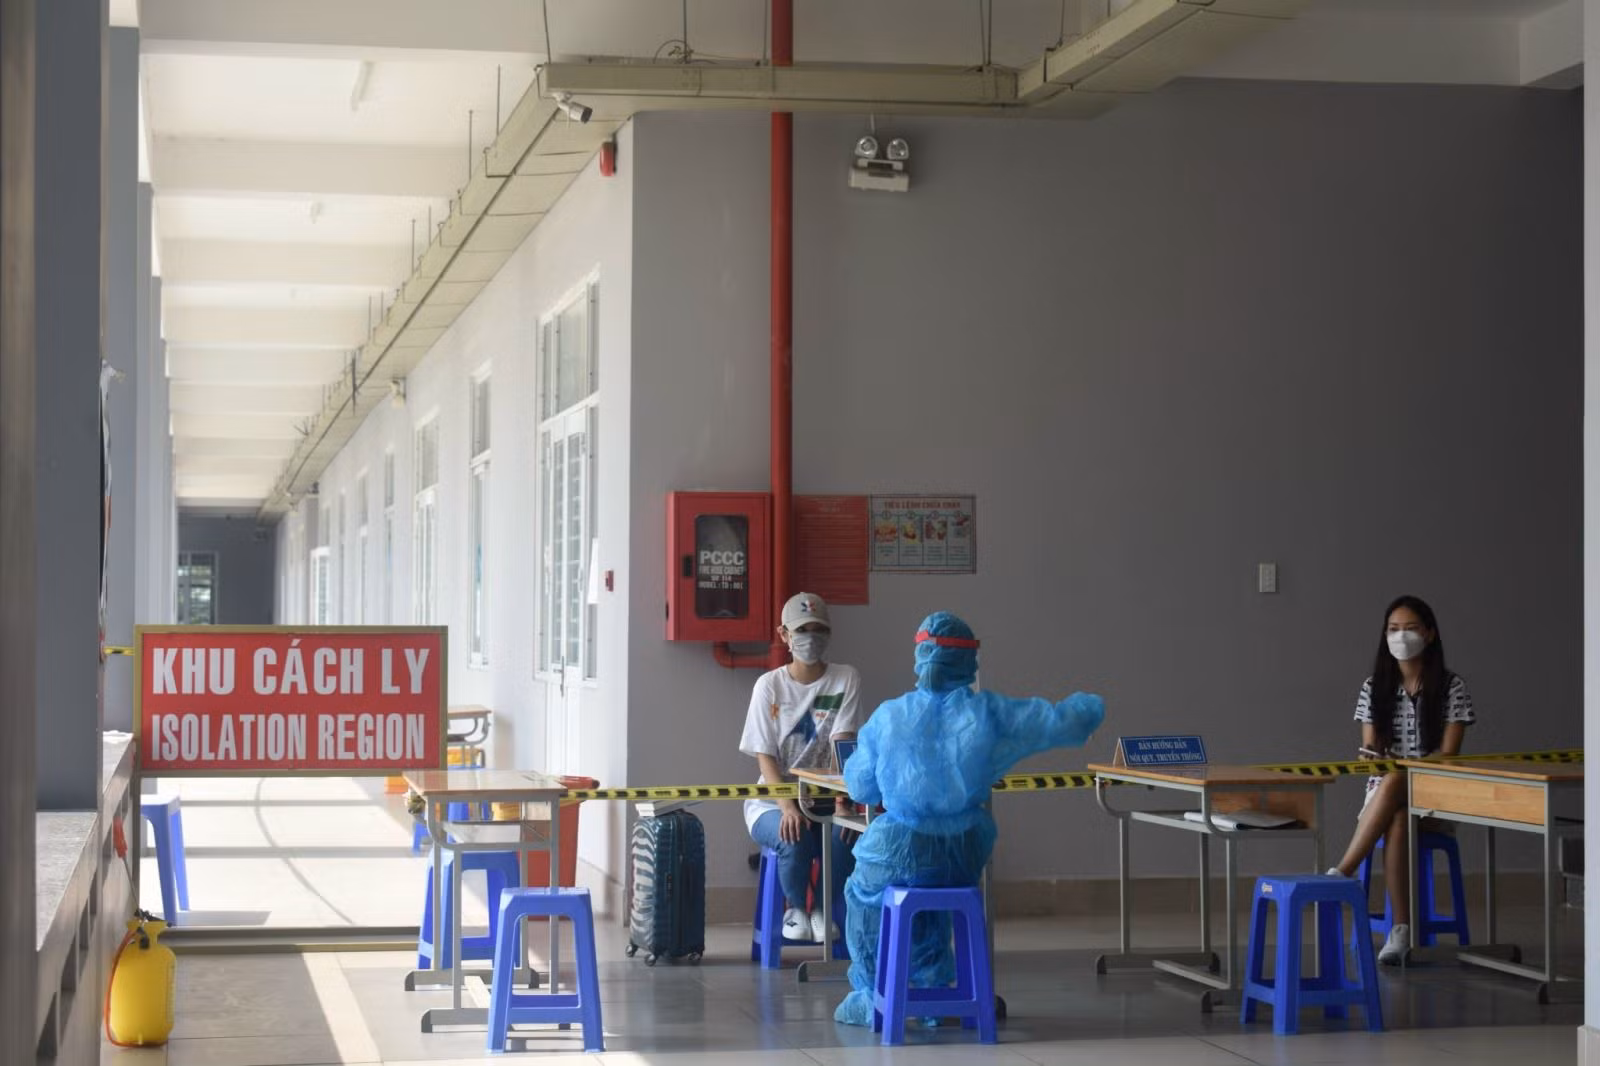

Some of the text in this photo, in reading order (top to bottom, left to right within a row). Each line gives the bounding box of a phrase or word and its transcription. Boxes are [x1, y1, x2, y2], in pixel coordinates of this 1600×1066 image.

[700, 550, 744, 566] PCCC
[153, 638, 430, 695] KHU CÁCH LY
[152, 713, 425, 761] ISOLATION REGION
